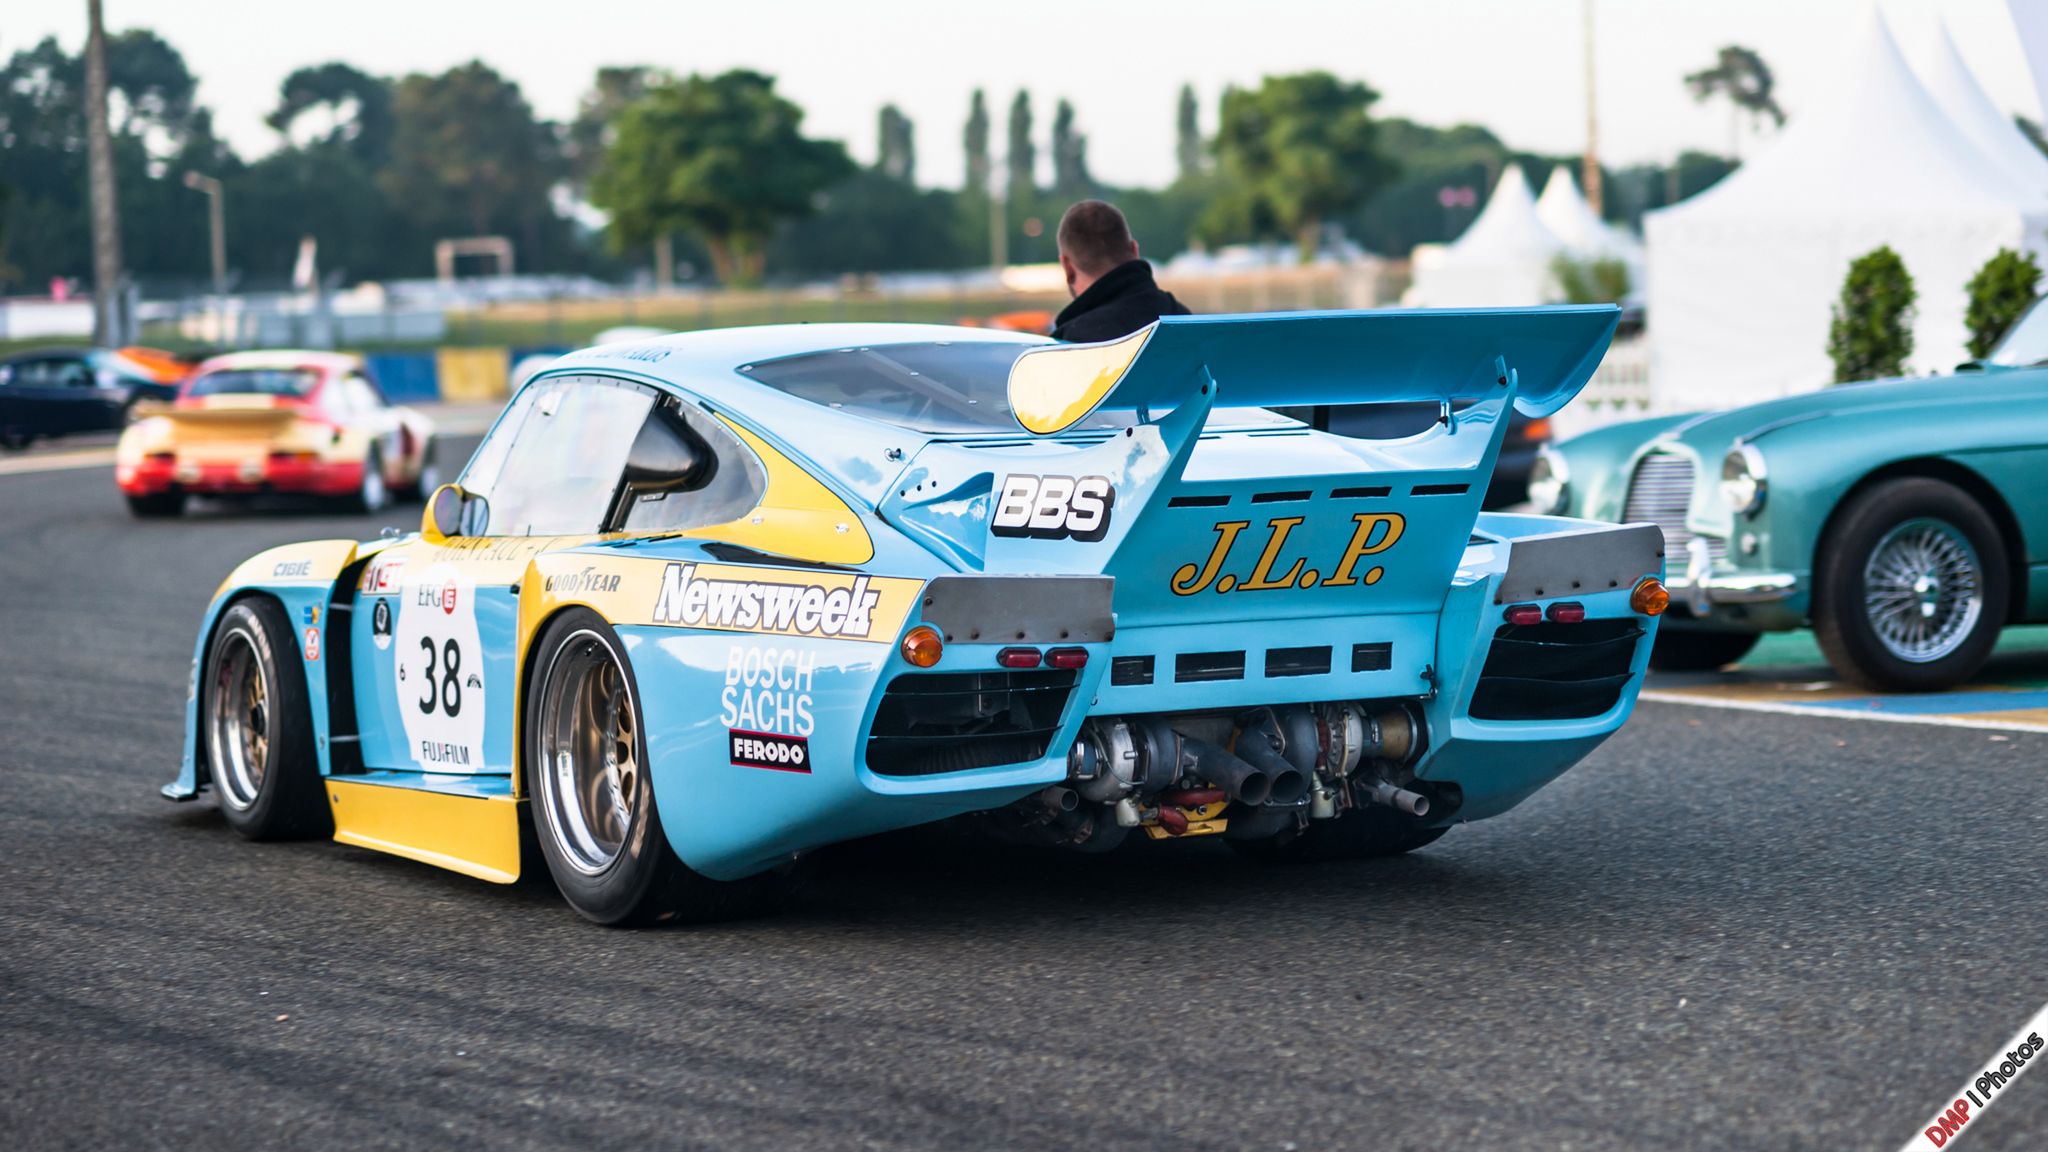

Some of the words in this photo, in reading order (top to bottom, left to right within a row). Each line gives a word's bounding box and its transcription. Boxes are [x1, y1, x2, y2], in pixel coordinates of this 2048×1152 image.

[990, 474, 1116, 543] BBS
[1170, 512, 1406, 597] J.L.P.
[418, 583, 441, 607] EFG
[653, 563, 881, 638] Newsweek
[419, 636, 461, 717] 38
[725, 647, 816, 692] BOSCH
[720, 686, 815, 737] SACHS
[733, 738, 804, 765] FERODO
